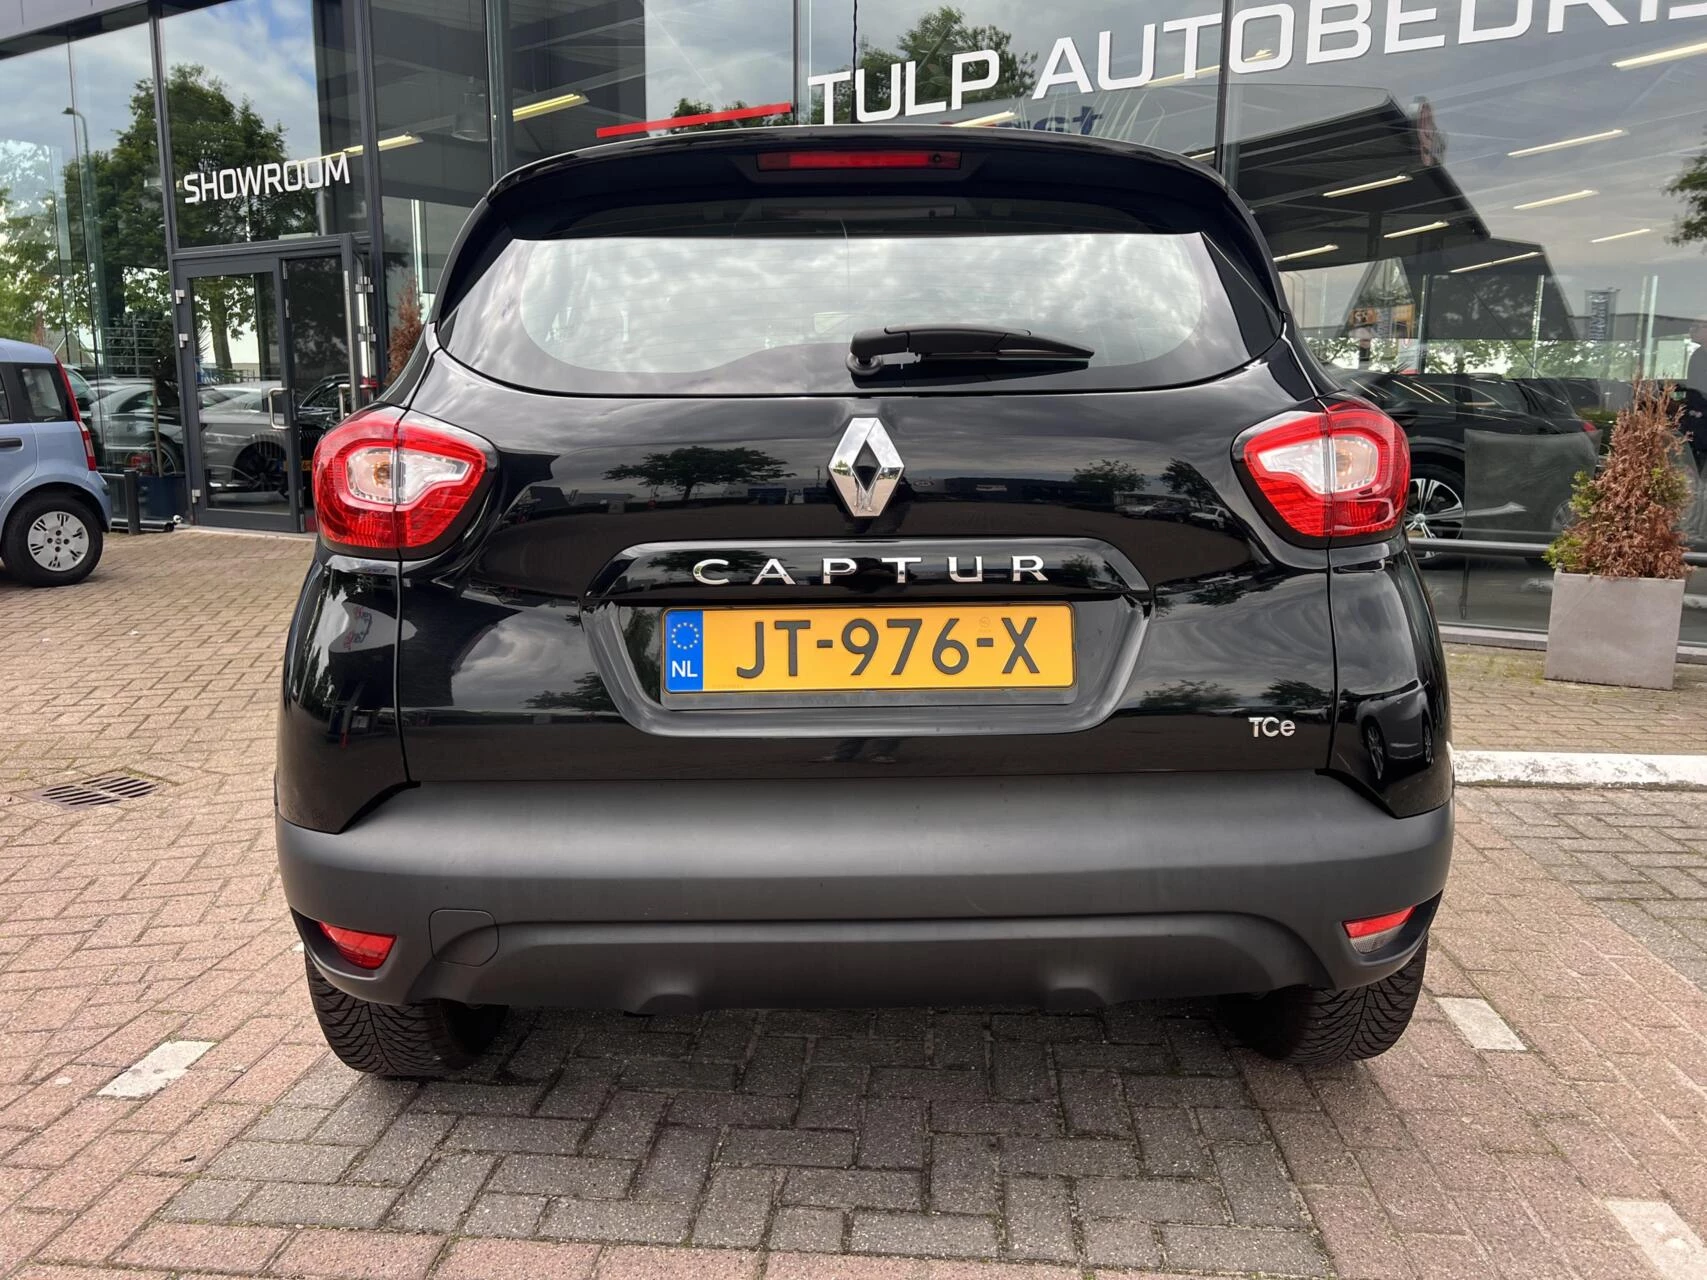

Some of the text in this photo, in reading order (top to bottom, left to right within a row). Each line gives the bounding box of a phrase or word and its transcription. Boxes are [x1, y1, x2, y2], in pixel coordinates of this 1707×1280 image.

[808, 49, 1000, 125] TULP
[183, 151, 350, 204] SHOWROOM
[693, 555, 1049, 585] CAPTUR
[736, 617, 1040, 679] JT-976-X
[671, 660, 698, 678] NL
[1247, 716, 1296, 738] TCe
